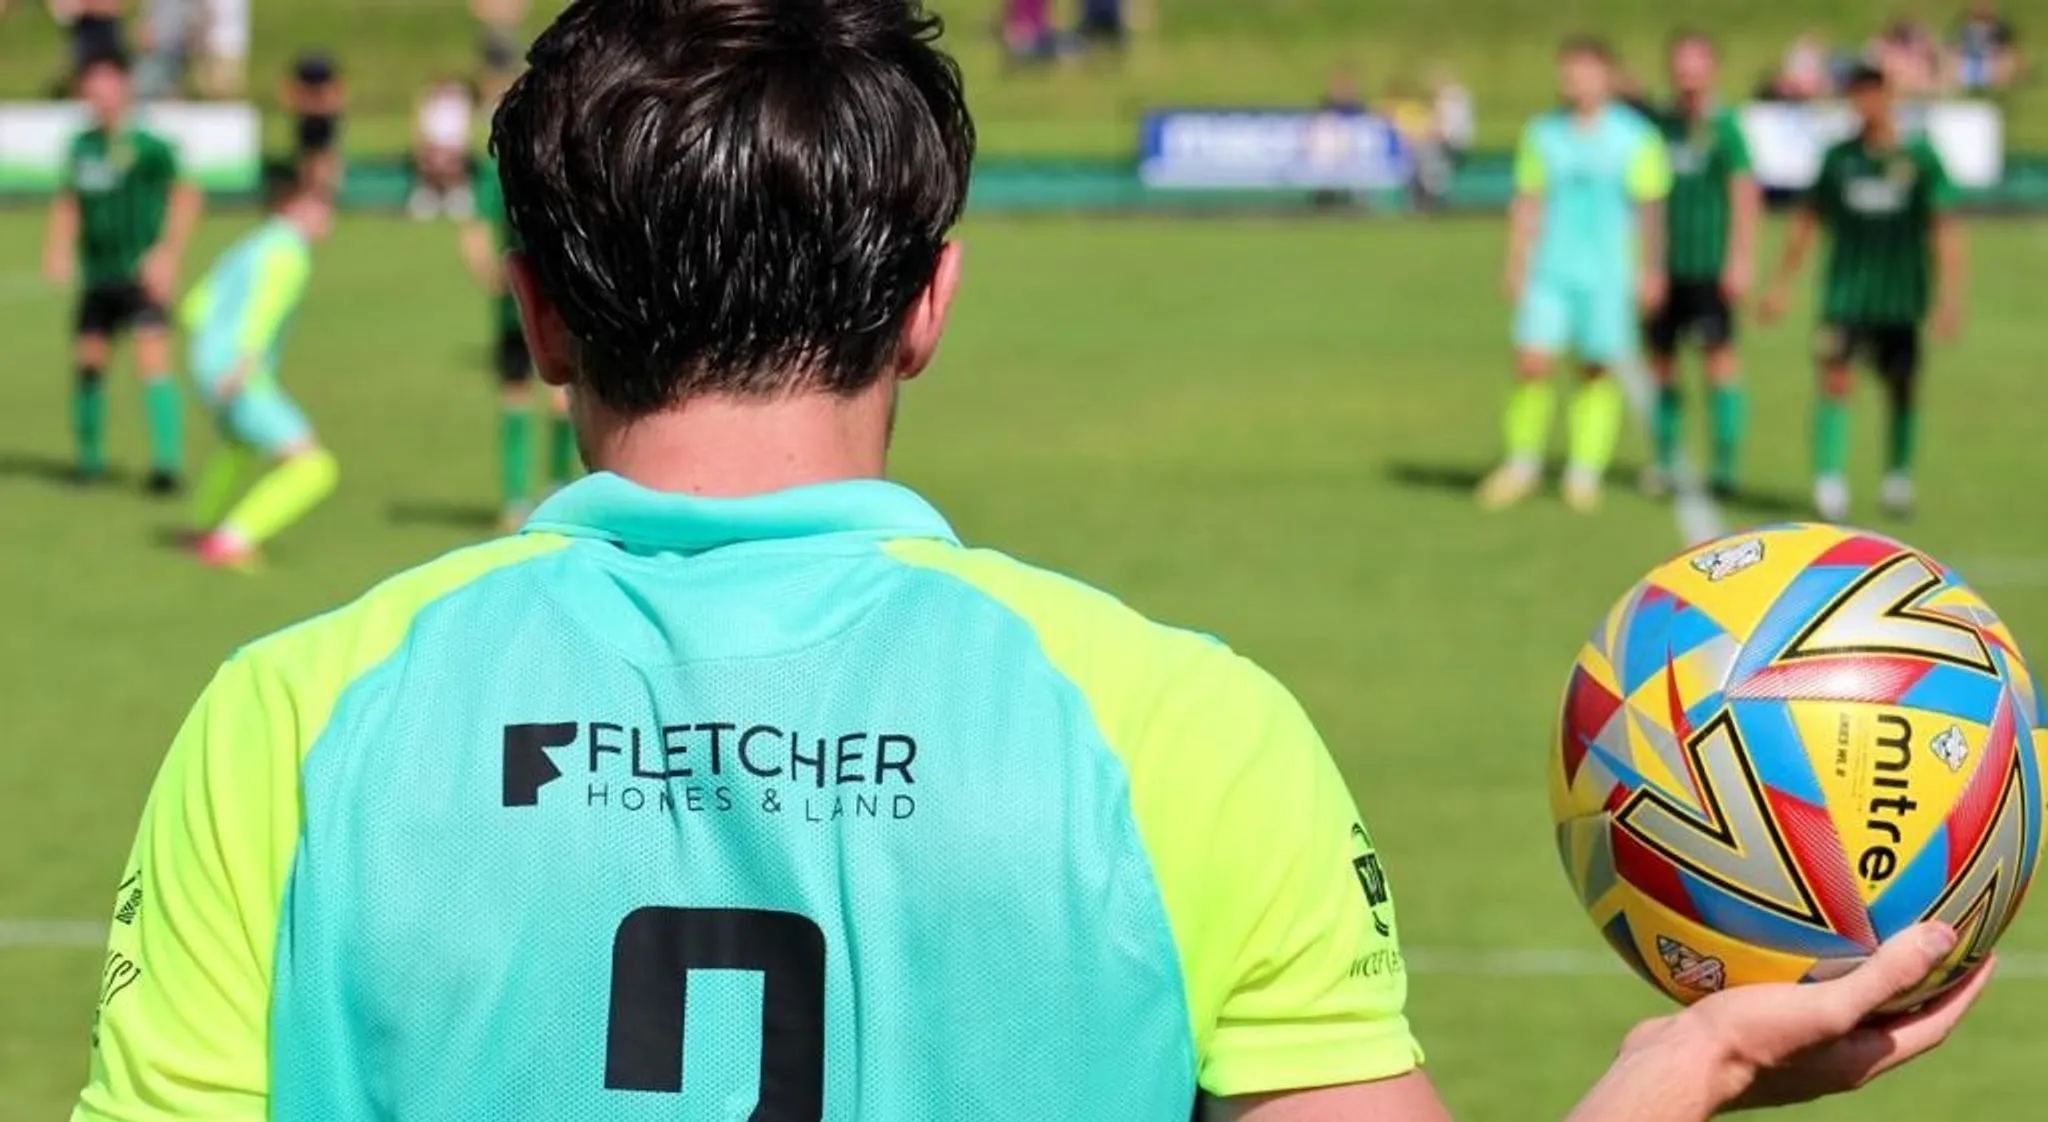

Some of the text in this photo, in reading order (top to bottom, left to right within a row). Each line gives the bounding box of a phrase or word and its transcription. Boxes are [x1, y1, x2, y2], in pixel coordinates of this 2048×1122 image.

[588, 722, 917, 788] FLETCHER
[762, 788, 782, 813] &
[806, 793, 916, 822] LAND
[1858, 714, 1918, 881] mitre
